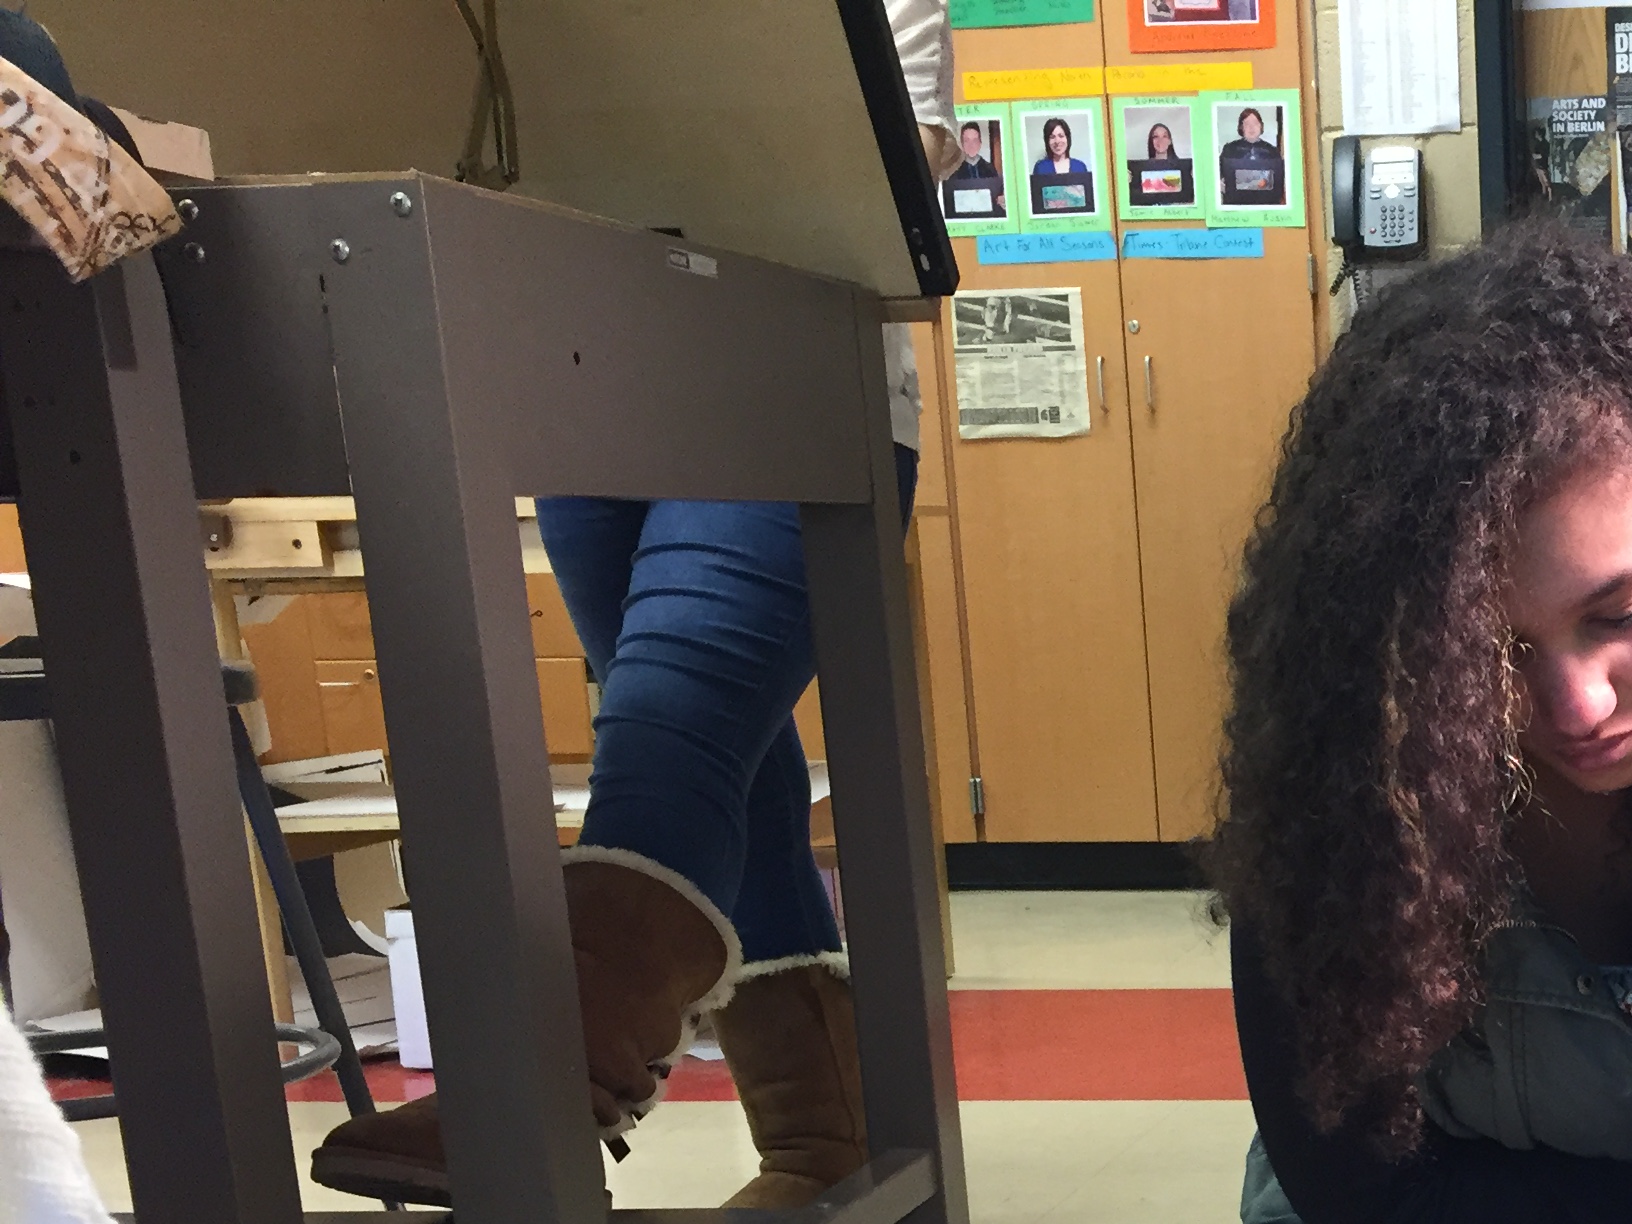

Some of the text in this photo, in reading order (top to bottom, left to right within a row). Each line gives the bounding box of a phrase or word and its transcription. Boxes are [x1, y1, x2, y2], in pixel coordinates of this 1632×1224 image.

[1134, 97, 1180, 105] SUMMER
[1225, 92, 1256, 101] FALL
[957, 105, 980, 115] TER
[1552, 99, 1579, 110] ARTS
[1581, 98, 1606, 109] AND
[1552, 110, 1597, 122] SOCIETY
[1552, 121, 1606, 133] IN BERLIN
[984, 239, 1009, 253] Art
[1039, 237, 1053, 248] All
[1060, 235, 1105, 252] Seasons
[1214, 234, 1254, 249] Contest
